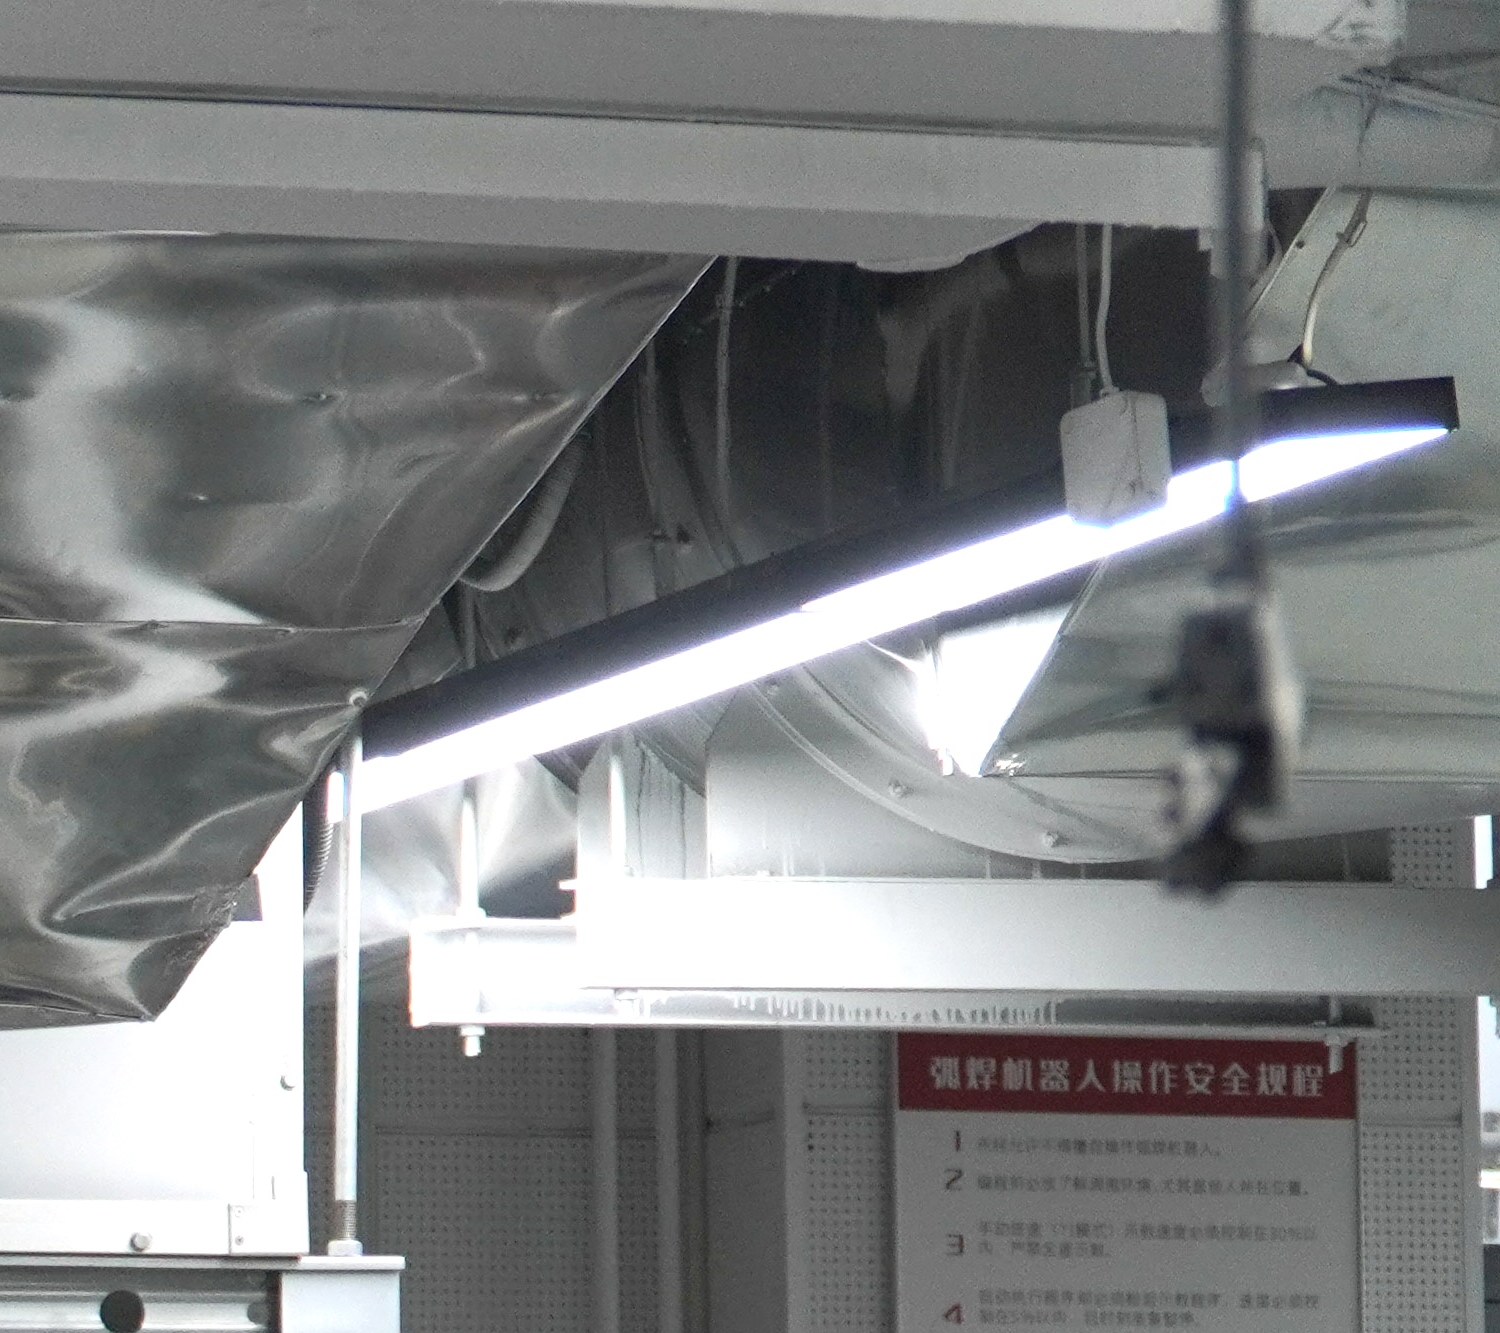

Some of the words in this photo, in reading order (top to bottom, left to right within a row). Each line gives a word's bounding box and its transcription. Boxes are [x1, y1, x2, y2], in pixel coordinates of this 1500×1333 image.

[929, 1055, 1325, 1099] 弧焊机器人操作安全规程
[952, 1130, 963, 1153] 1
[943, 1168, 964, 1192] 2
[944, 1233, 966, 1257] 3
[942, 1303, 965, 1326] 4
